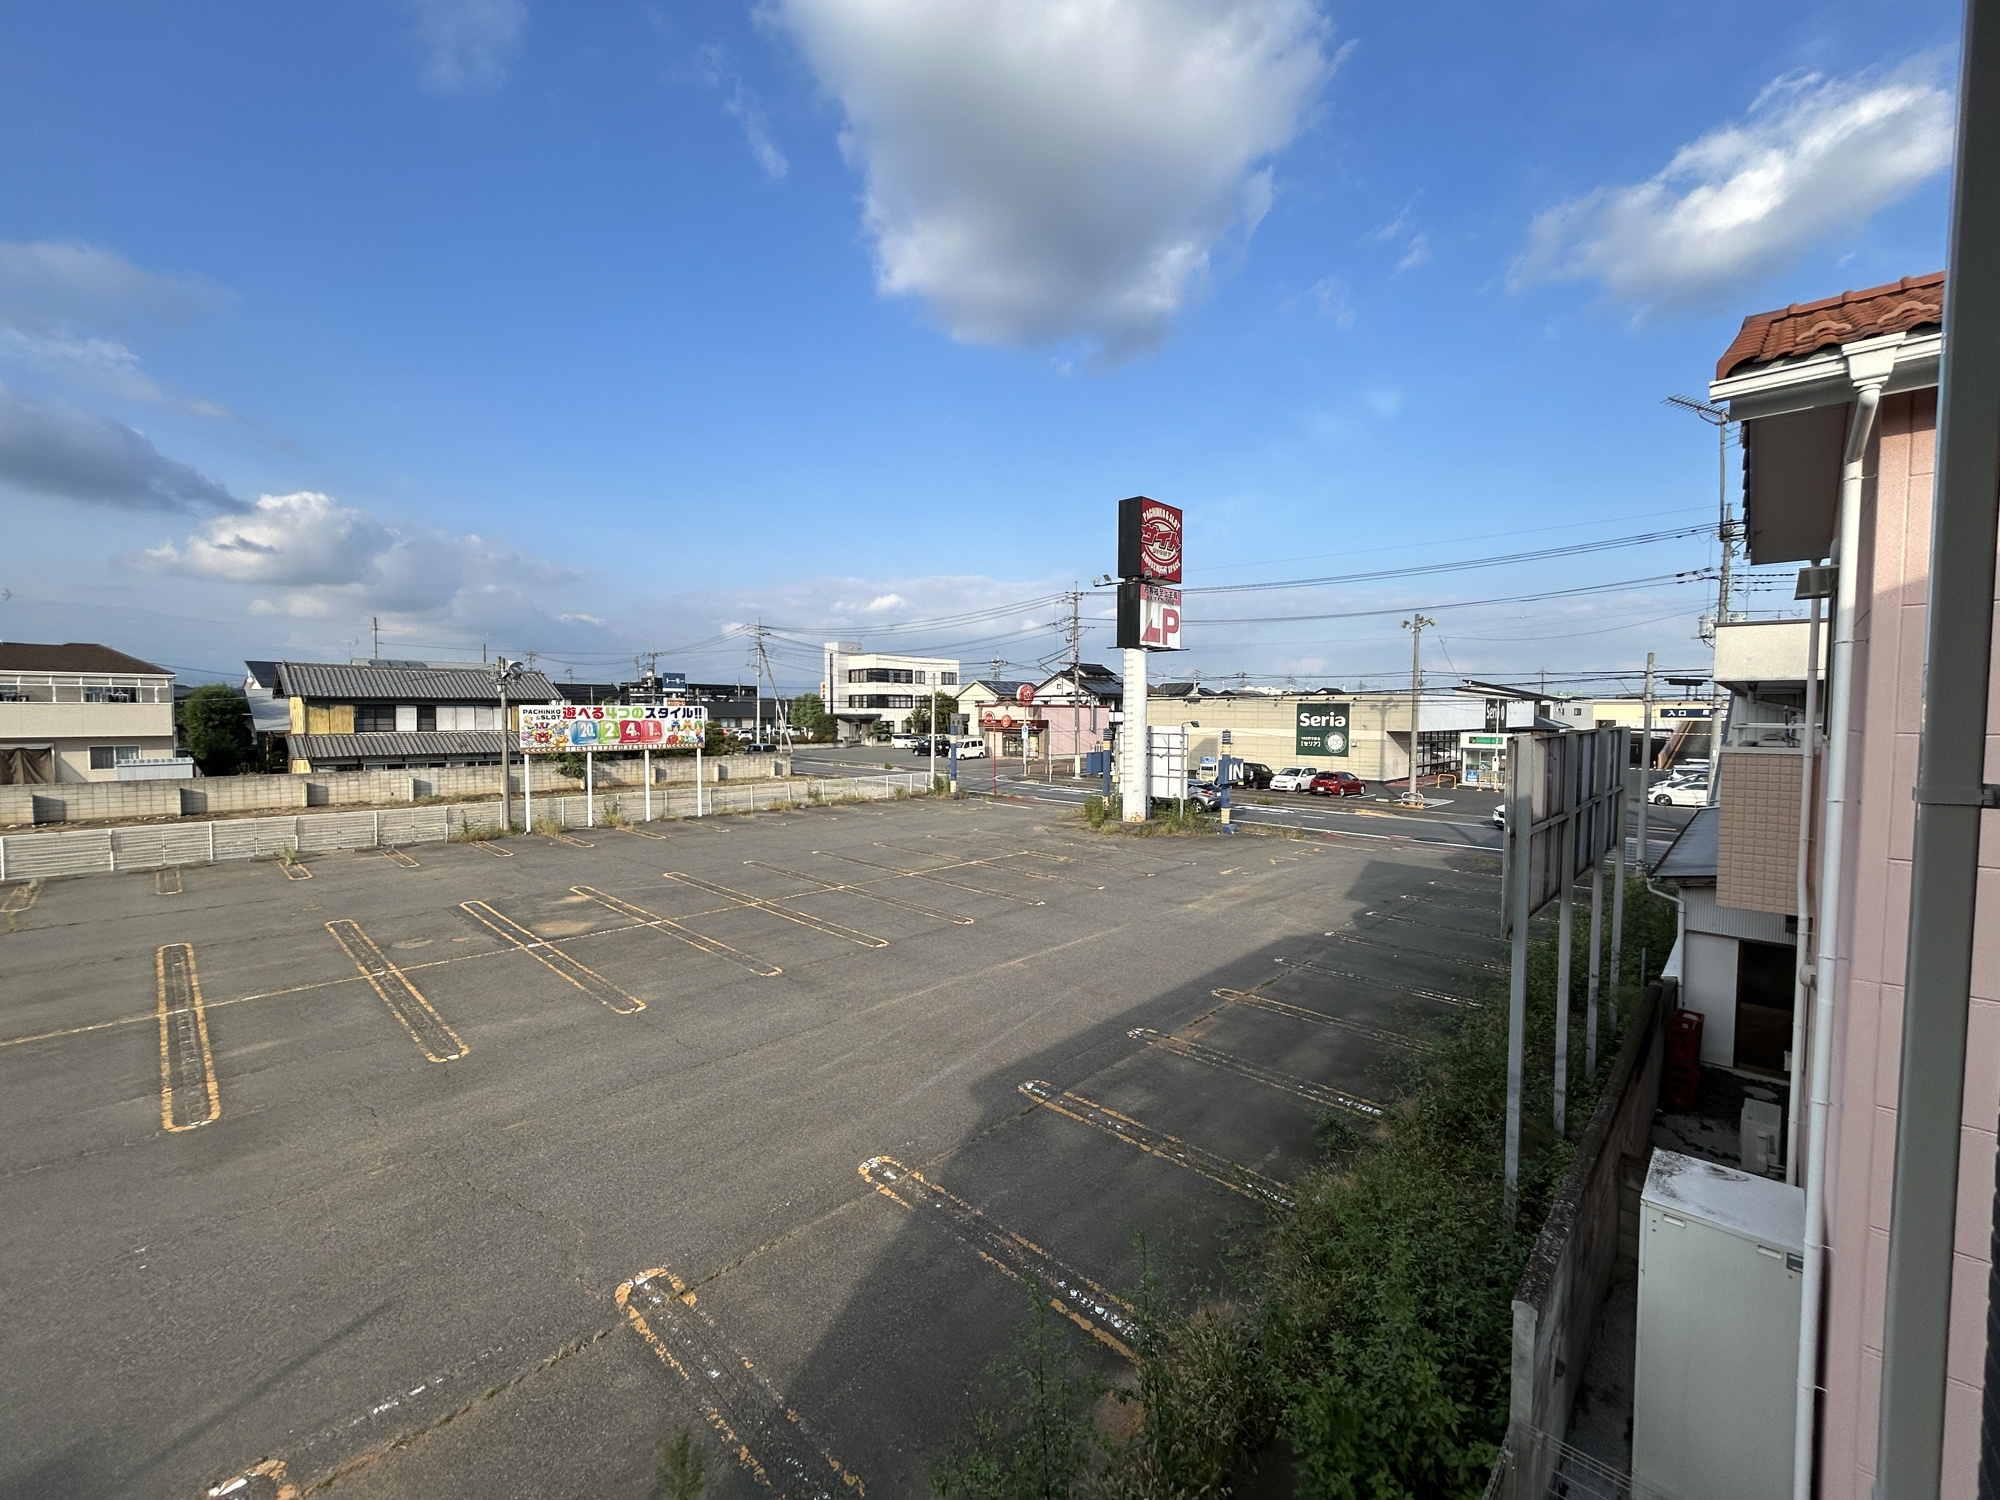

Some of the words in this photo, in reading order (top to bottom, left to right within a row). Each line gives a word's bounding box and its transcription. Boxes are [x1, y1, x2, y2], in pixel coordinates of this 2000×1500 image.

[1167, 558, 1181, 575] SPACE
[1162, 608, 1180, 645] P
[1299, 711, 1346, 727] Seria
[1667, 709, 1687, 717] 入口
[1229, 763, 1244, 780] IN
